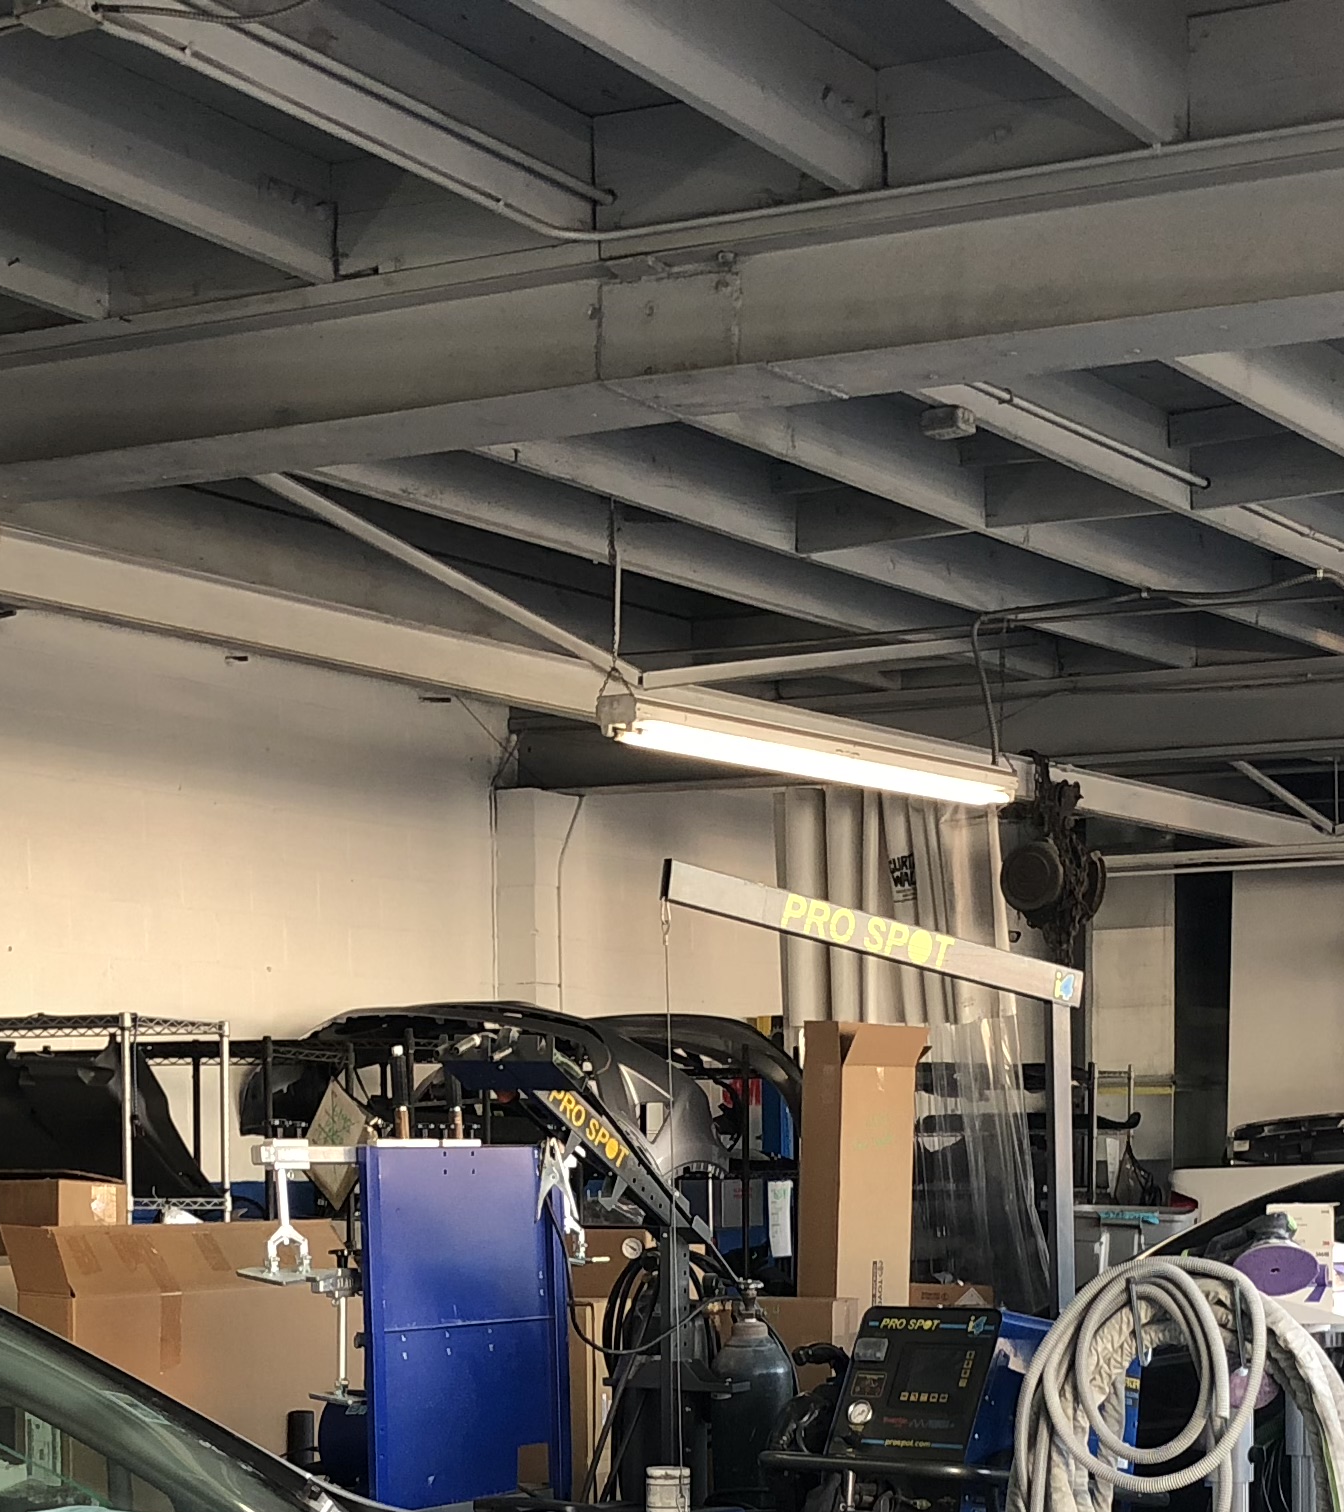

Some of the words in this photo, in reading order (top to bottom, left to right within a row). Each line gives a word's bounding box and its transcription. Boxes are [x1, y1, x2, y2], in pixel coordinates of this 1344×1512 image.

[779, 893, 856, 944] PRO
[863, 915, 956, 969] SPOT
[548, 1090, 586, 1128] PRO
[585, 1119, 630, 1168] SPOT
[879, 1318, 906, 1330] PRO
[908, 1319, 941, 1331] SPOT
[884, 1438, 931, 1448] prospot.com
